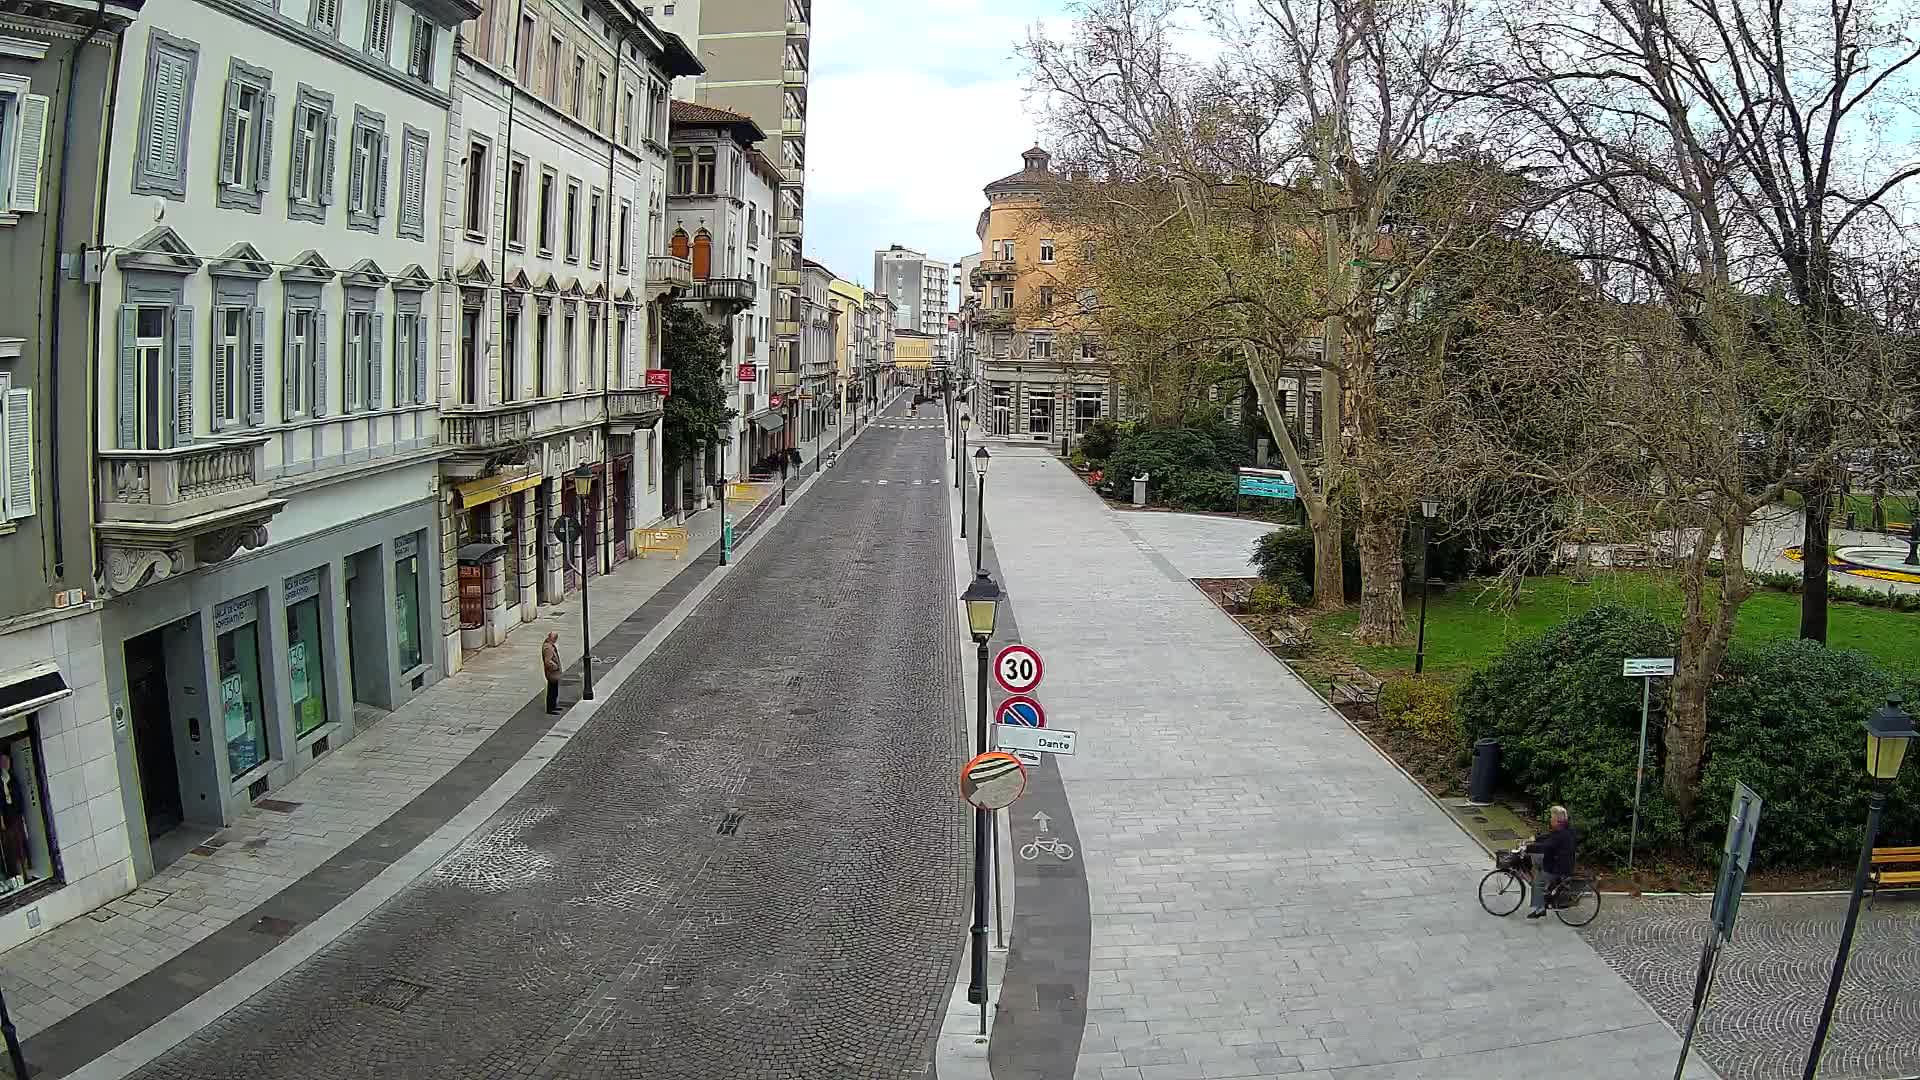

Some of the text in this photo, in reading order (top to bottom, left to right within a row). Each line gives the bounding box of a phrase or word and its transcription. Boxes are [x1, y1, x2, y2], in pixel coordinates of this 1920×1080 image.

[1005, 658, 1033, 681] 30
[223, 679, 241, 704] 130
[1038, 738, 1070, 750] Dante
